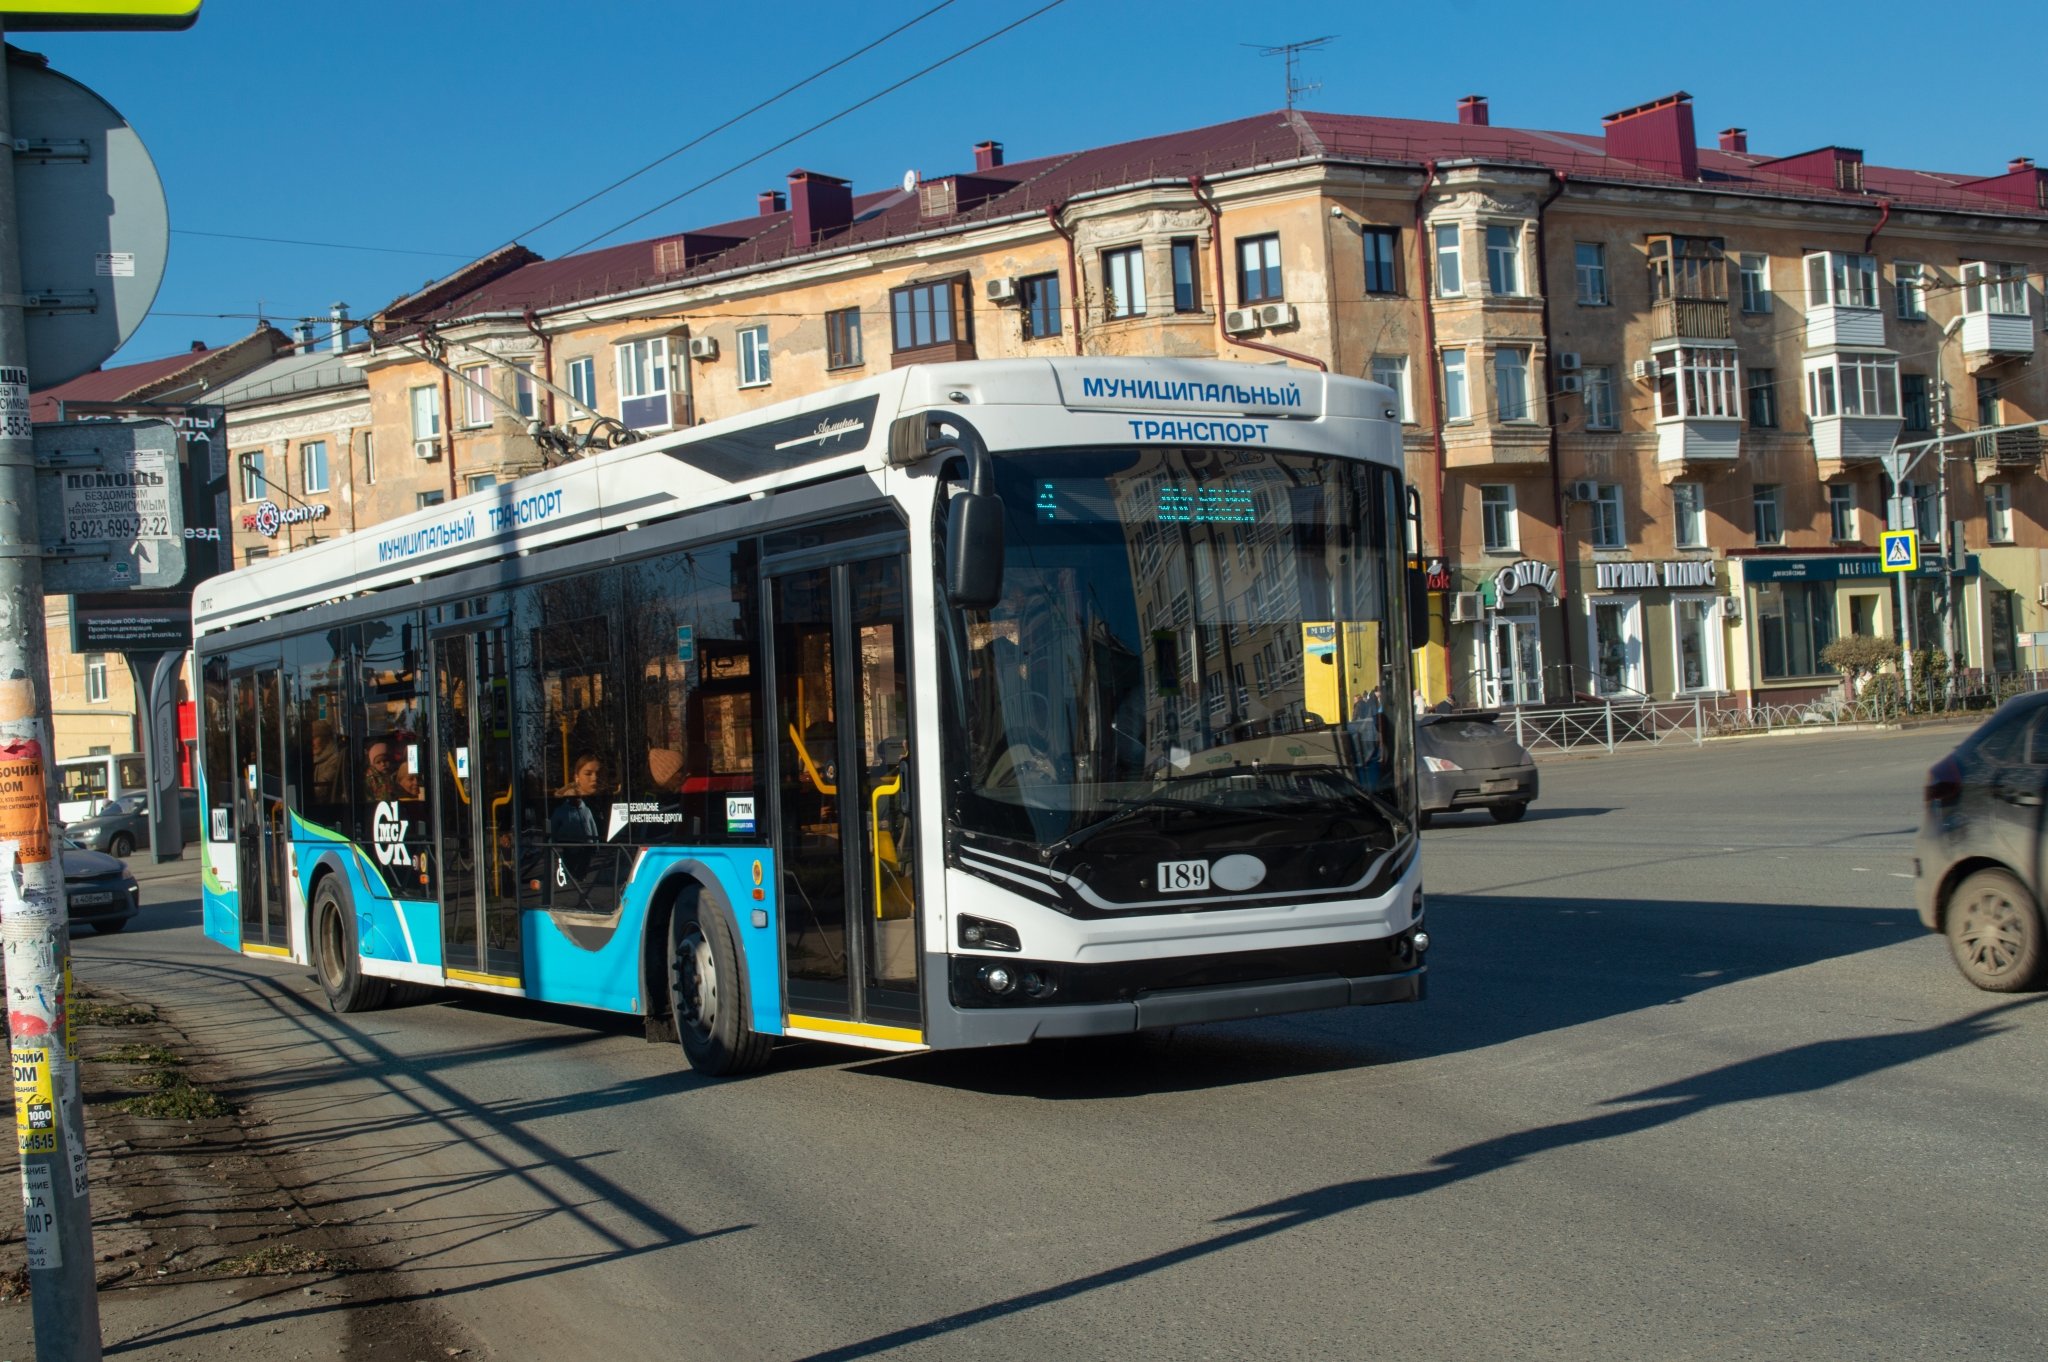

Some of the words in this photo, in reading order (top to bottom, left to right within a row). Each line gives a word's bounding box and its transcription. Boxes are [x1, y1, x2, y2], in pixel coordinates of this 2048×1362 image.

[1083, 377, 1302, 407] МУНИЦИПАЛЬНЫЙ
[1128, 420, 1269, 443] ТРАНСПОРТ
[67, 471, 164, 488] ПОМОЩЬ
[84, 489, 148, 500] БЕЗДОМНЫМ
[101, 499, 166, 513] ЗАВИСИМЫМ
[69, 517, 168, 540] 8-923-699-22-22
[379, 510, 475, 563] МУНИЦИПАЛЬНЫЙ
[488, 489, 562, 532] ТРАНСПОРТ
[1596, 563, 1660, 588] ПРИМА
[1663, 560, 1716, 587] ПЛЮС
[629, 802, 660, 812] БЕЗОПАСНЫЕ
[214, 812, 227, 838] 189
[629, 813, 663, 823] КАЧЕСТВЕННЫЕ
[663, 813, 683, 825] ДОРОГИ
[1161, 863, 1205, 889] 189
[28, 1110, 52, 1121] 1000
[45, 1213, 53, 1232] Р
